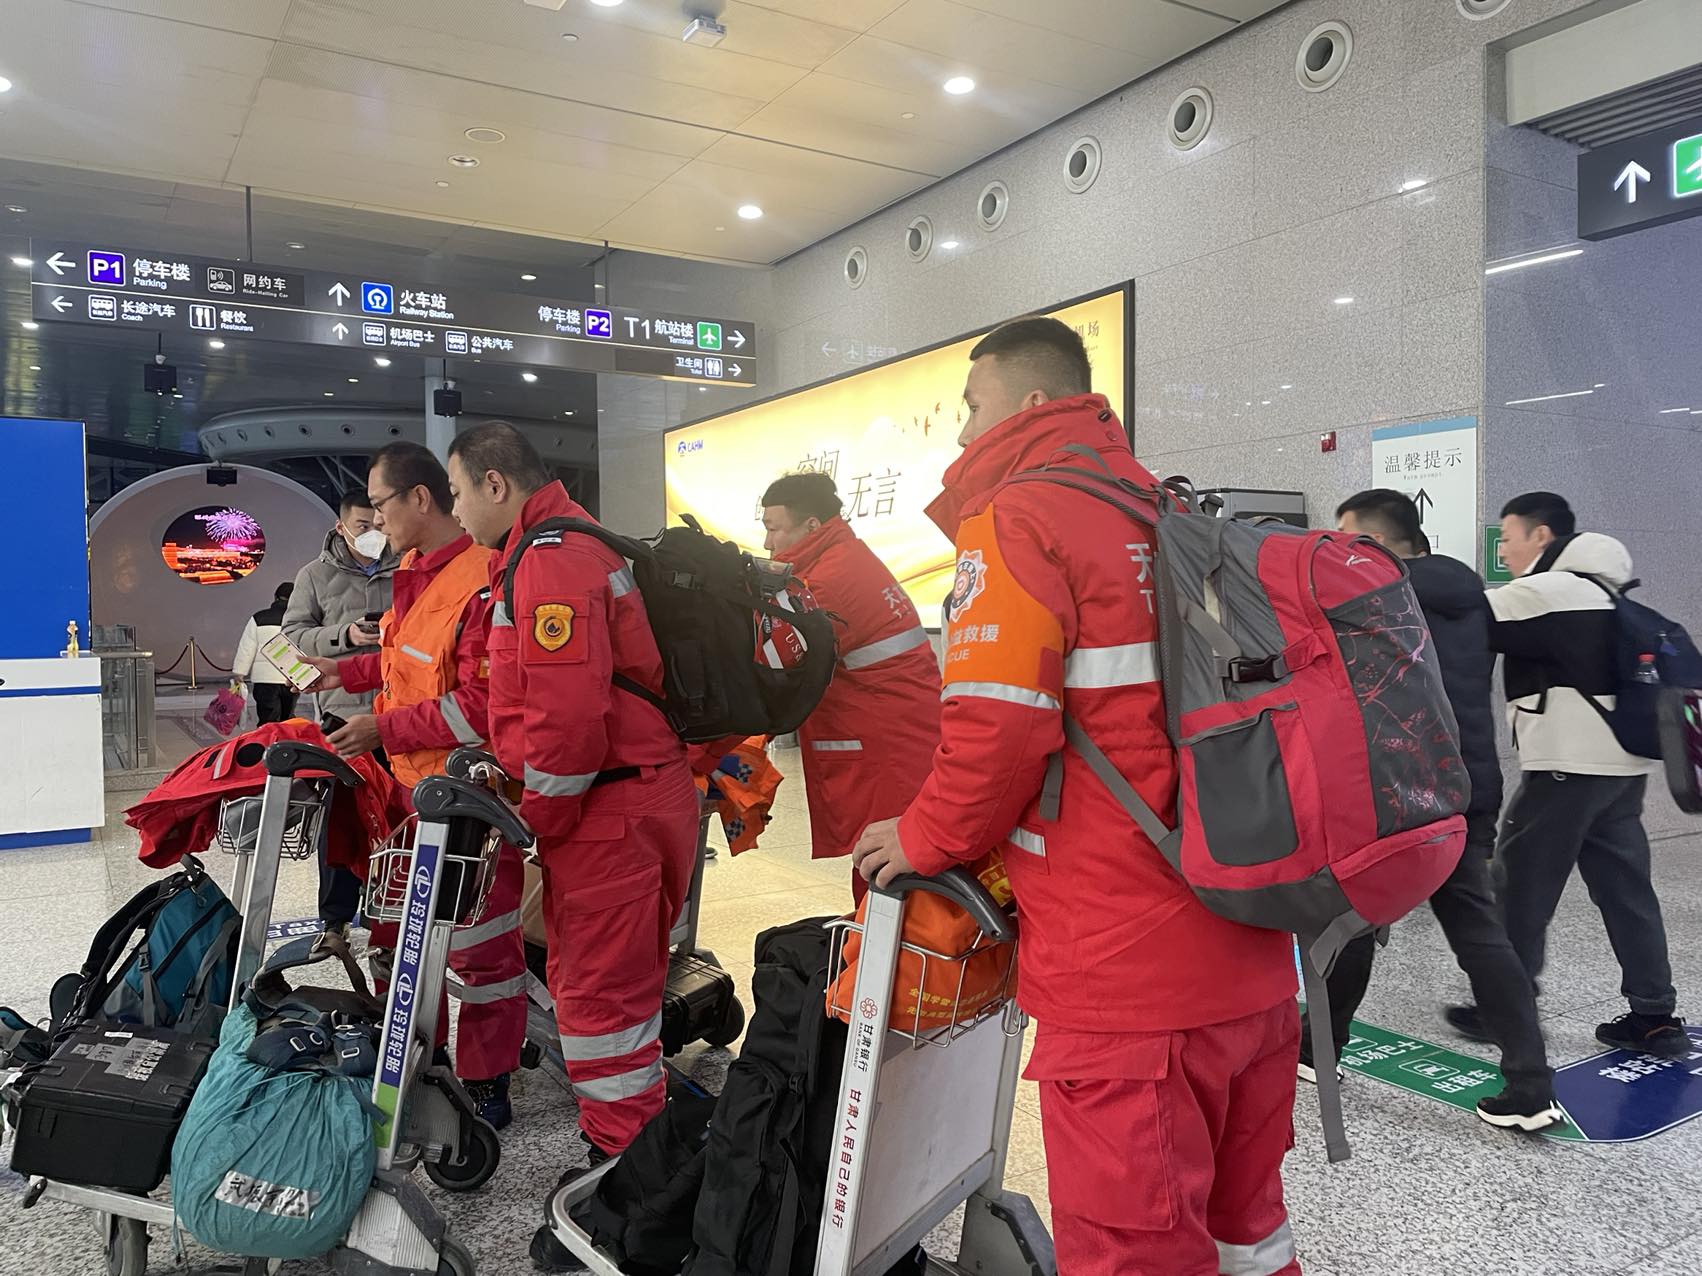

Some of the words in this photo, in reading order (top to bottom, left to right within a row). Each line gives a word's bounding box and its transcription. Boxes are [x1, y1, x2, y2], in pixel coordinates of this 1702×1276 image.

[93, 258, 120, 278] P1
[133, 258, 190, 281] 停车楼
[133, 277, 167, 290] Parking
[243, 273, 287, 291] 网约车
[121, 300, 176, 318] 长途汽车
[400, 290, 447, 310] 火车站
[121, 313, 143, 322] Coach
[220, 310, 247, 324] 餐饮
[400, 306, 428, 318] Railway
[429, 309, 454, 320] Station
[538, 305, 581, 325] 停车楼
[220, 322, 254, 332] Restaurant
[556, 323, 581, 335] Parking
[588, 315, 610, 332] P2
[624, 316, 650, 340] T1
[655, 319, 695, 338] 航站楼
[389, 327, 435, 343] 机场巴士
[390, 340, 408, 348] Airport
[471, 335, 514, 351] 公共汽车
[669, 335, 695, 346] Terminal
[675, 357, 703, 369] 卫生间
[1384, 447, 1462, 474] 温馨提示
[403, 899, 426, 966] 玲珑轮胎
[385, 1007, 408, 1074] 玲珑轮胎
[857, 1024, 874, 1073] 甘肃银行
[1431, 1069, 1498, 1093] 出租车
[832, 1088, 862, 1230] 甘肃人民自己的银行
